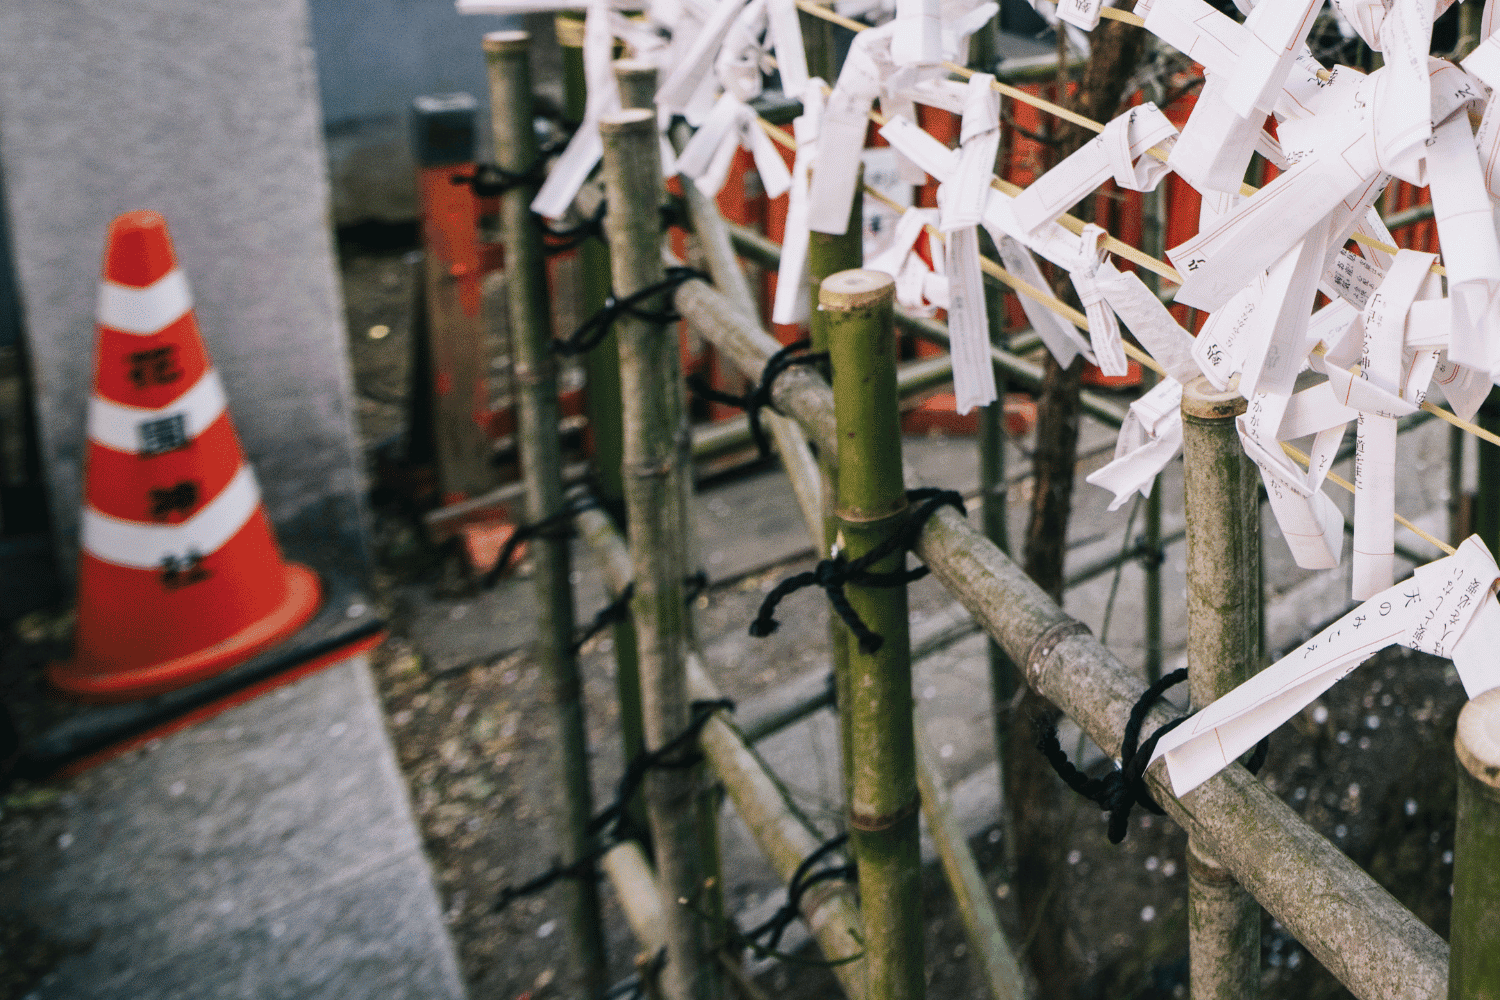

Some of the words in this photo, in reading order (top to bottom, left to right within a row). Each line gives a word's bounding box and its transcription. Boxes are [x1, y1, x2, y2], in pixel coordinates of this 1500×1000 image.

[1299, 585, 1425, 659] 天のみこえ
